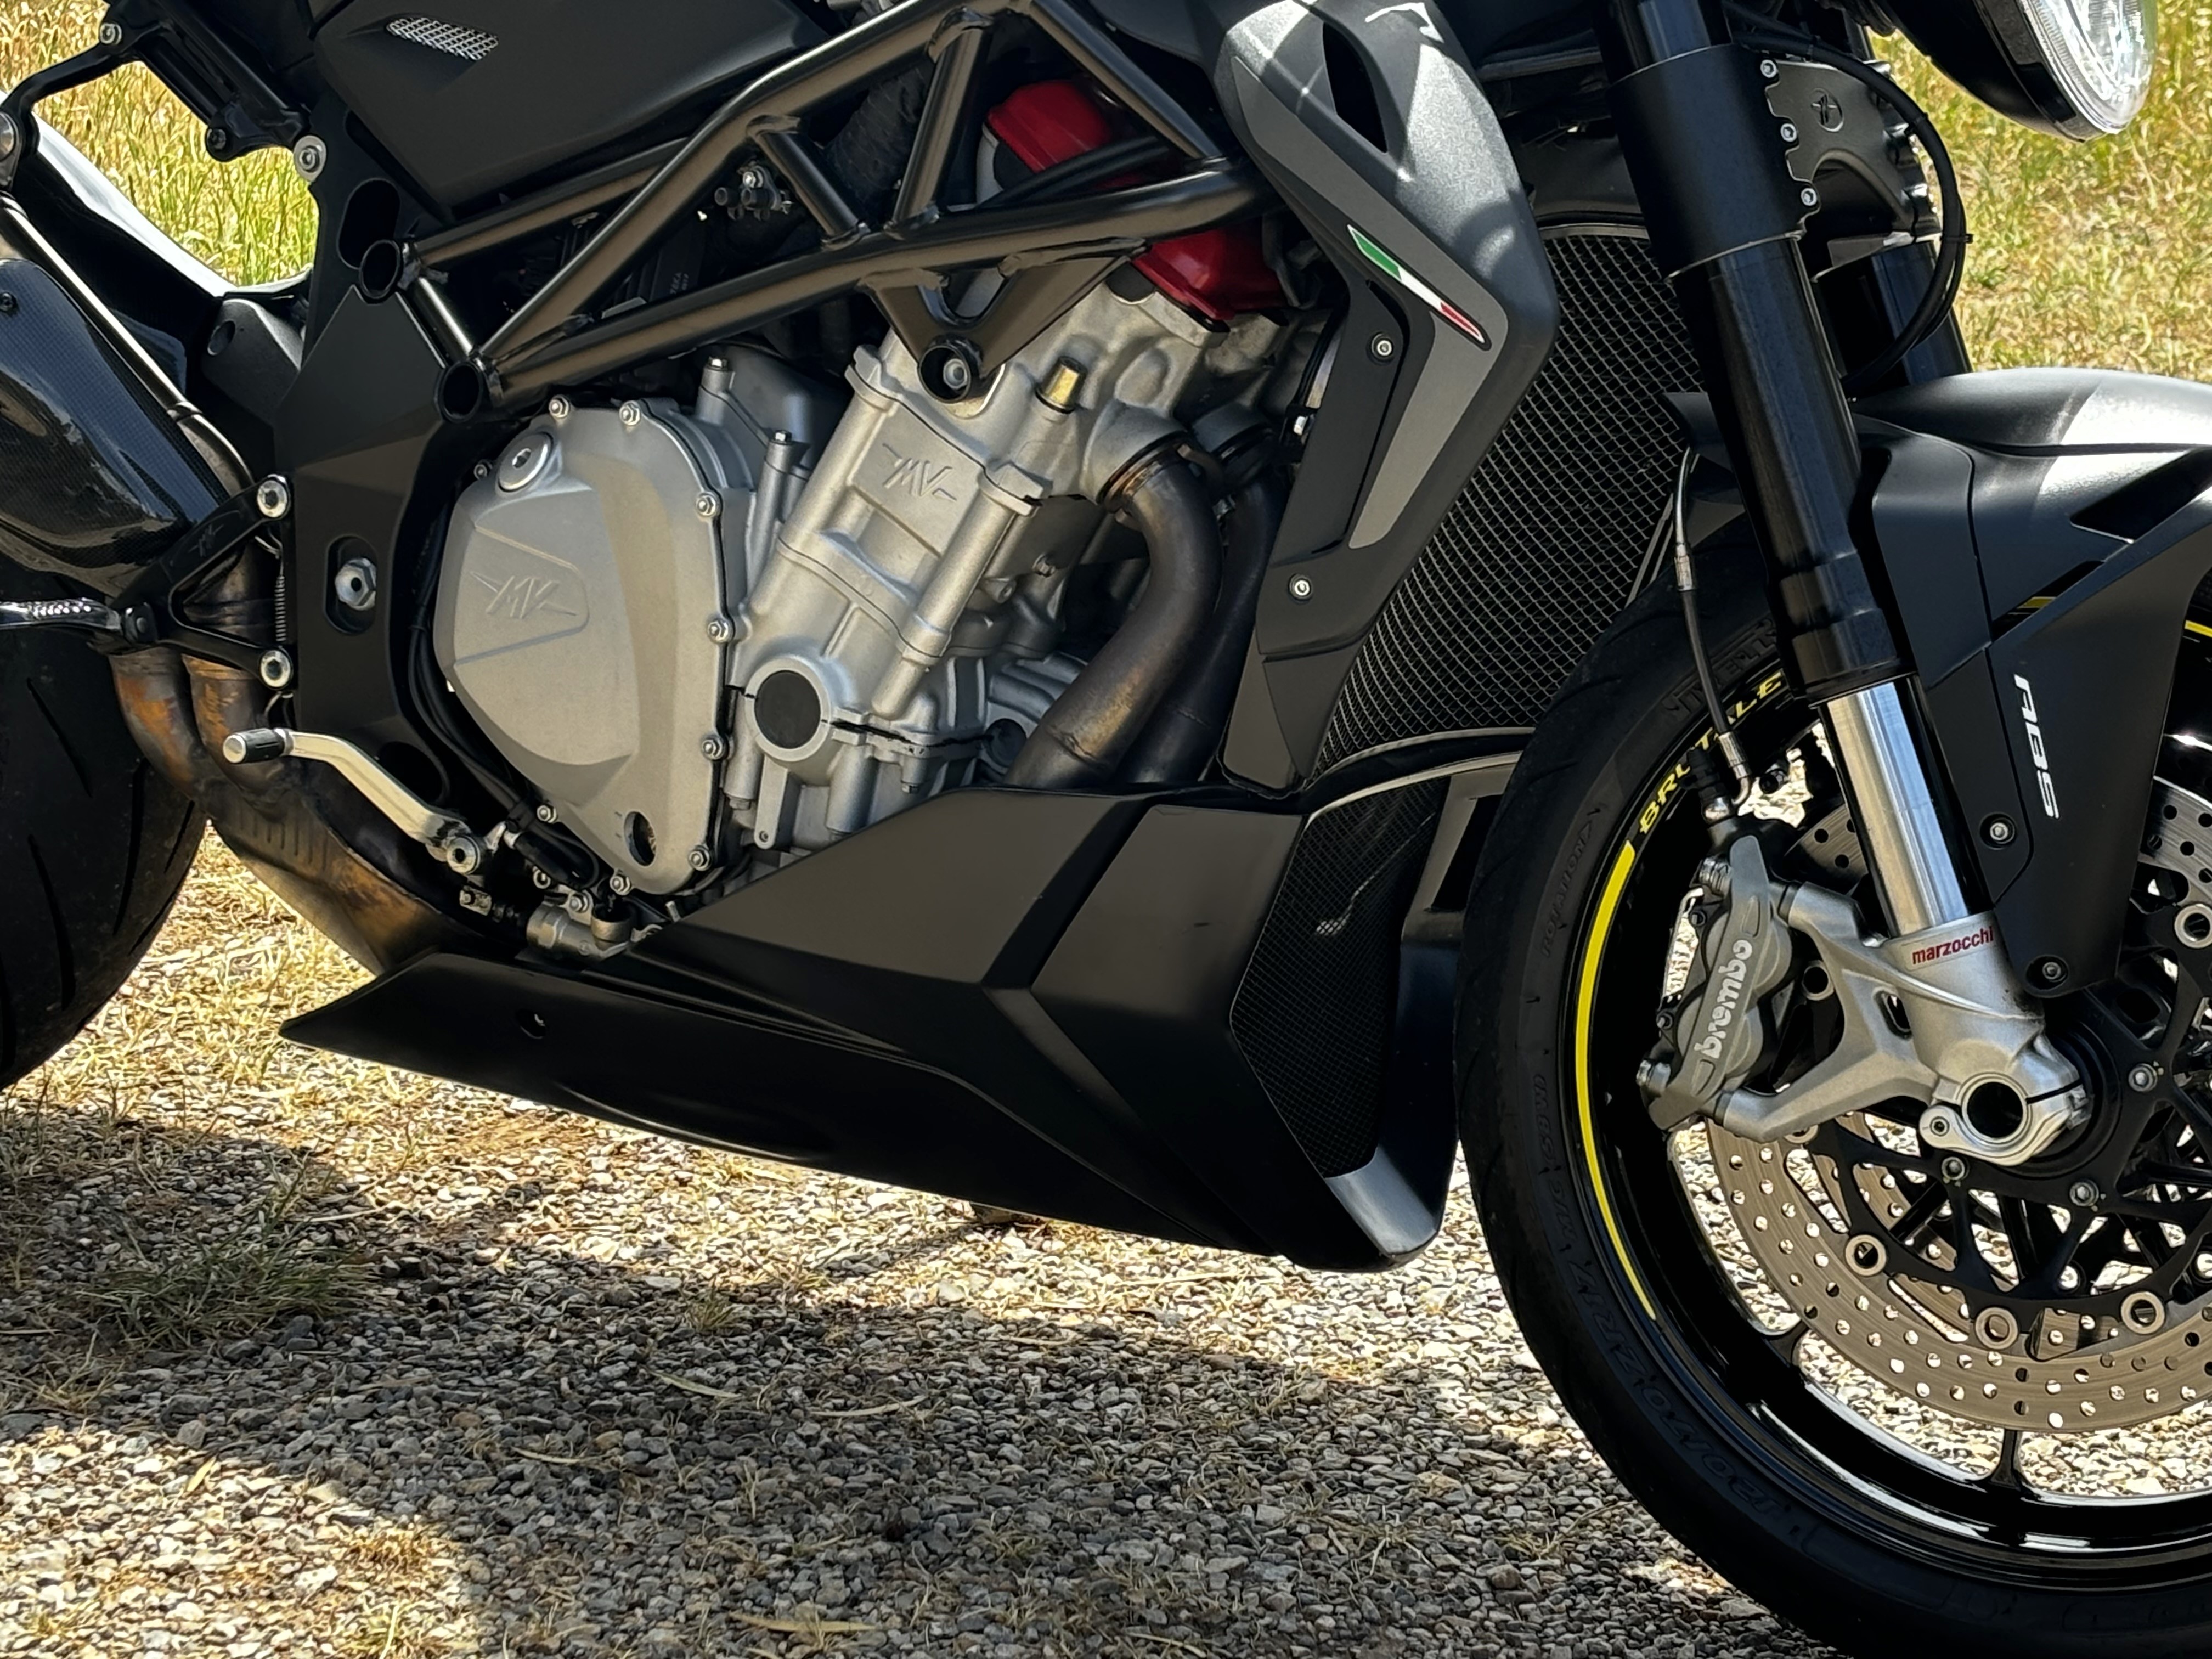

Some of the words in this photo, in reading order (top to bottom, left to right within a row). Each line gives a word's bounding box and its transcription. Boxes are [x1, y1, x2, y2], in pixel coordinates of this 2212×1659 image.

[2014, 674, 2059, 818] ABS
[1542, 839, 1587, 958] ROTATION
[1912, 926, 1994, 965] marzocchi
